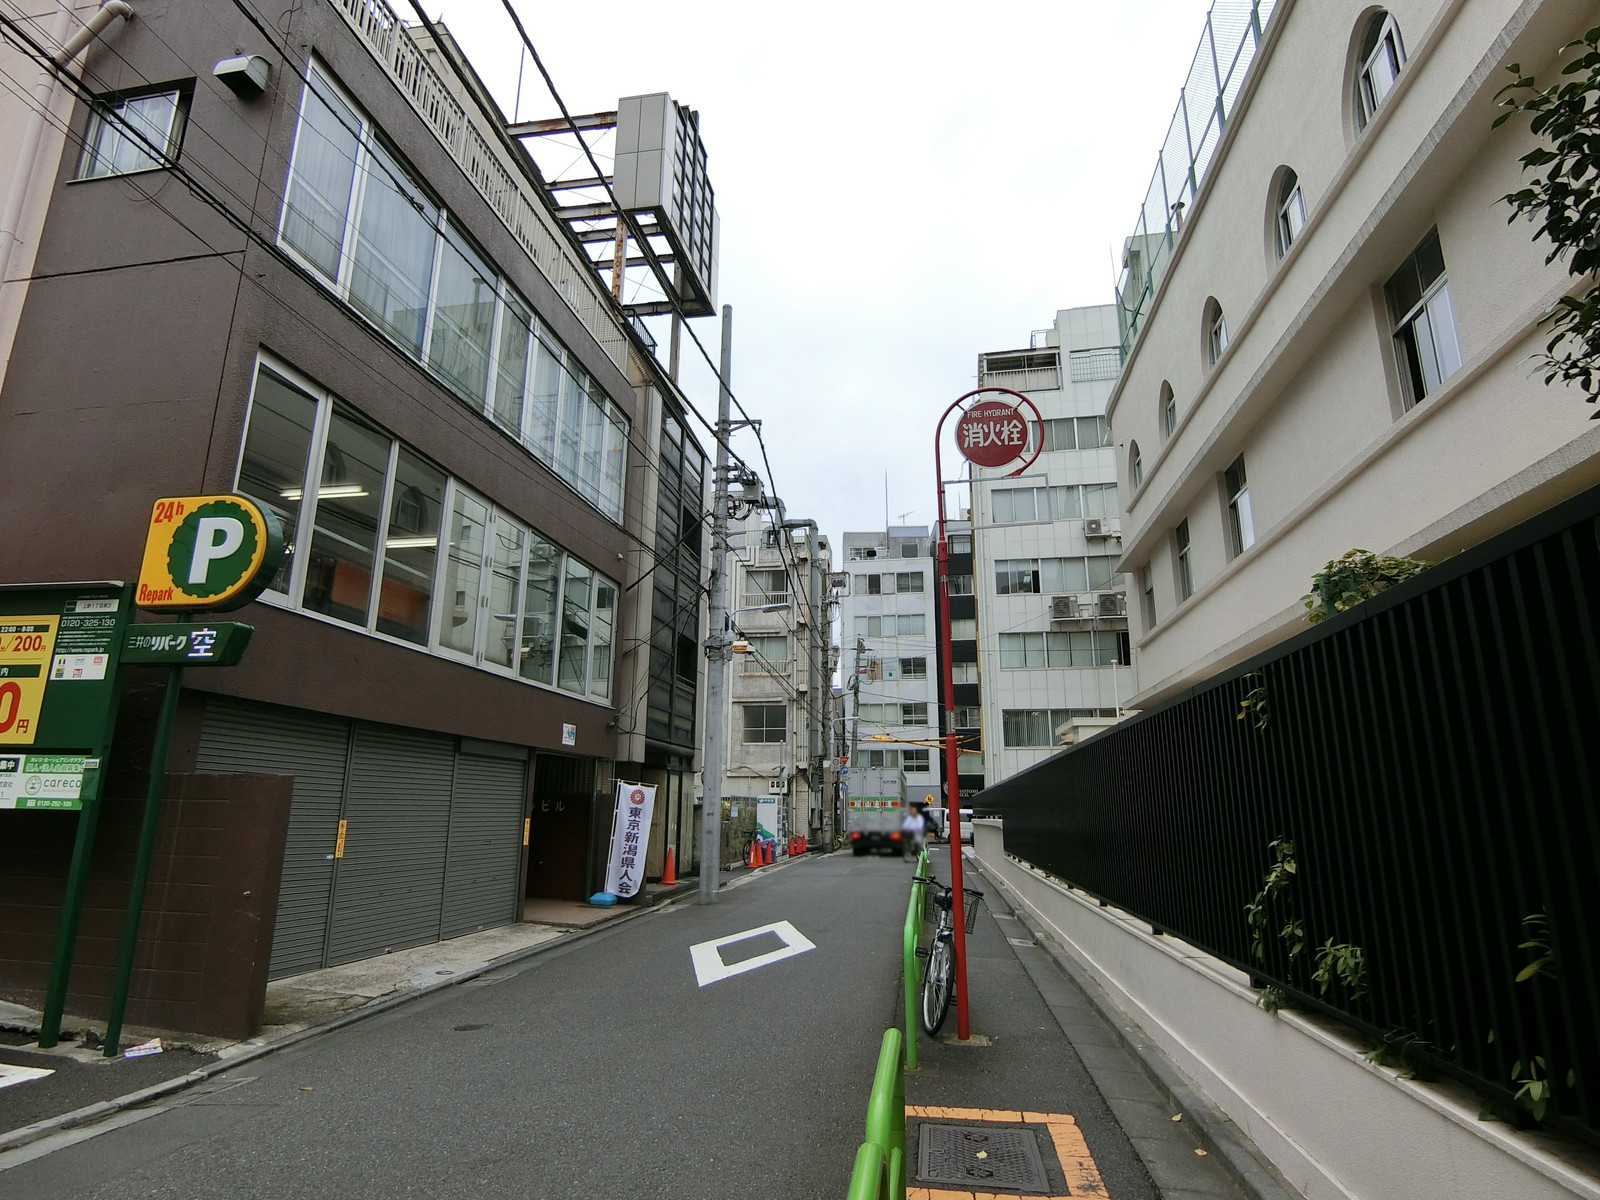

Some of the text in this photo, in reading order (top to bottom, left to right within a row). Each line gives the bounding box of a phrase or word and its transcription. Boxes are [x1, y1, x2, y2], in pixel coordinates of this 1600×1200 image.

[984, 408, 1014, 417] HYDRANT
[962, 419, 1023, 448] 消火栓
[154, 502, 184, 523] 24h
[188, 517, 244, 584] P
[138, 584, 173, 603] Repark
[128, 634, 187, 651] 三井のリパーク
[187, 627, 218, 657] 空
[43, 778, 81, 788] careco
[618, 806, 642, 895] 東京新潟県人会
